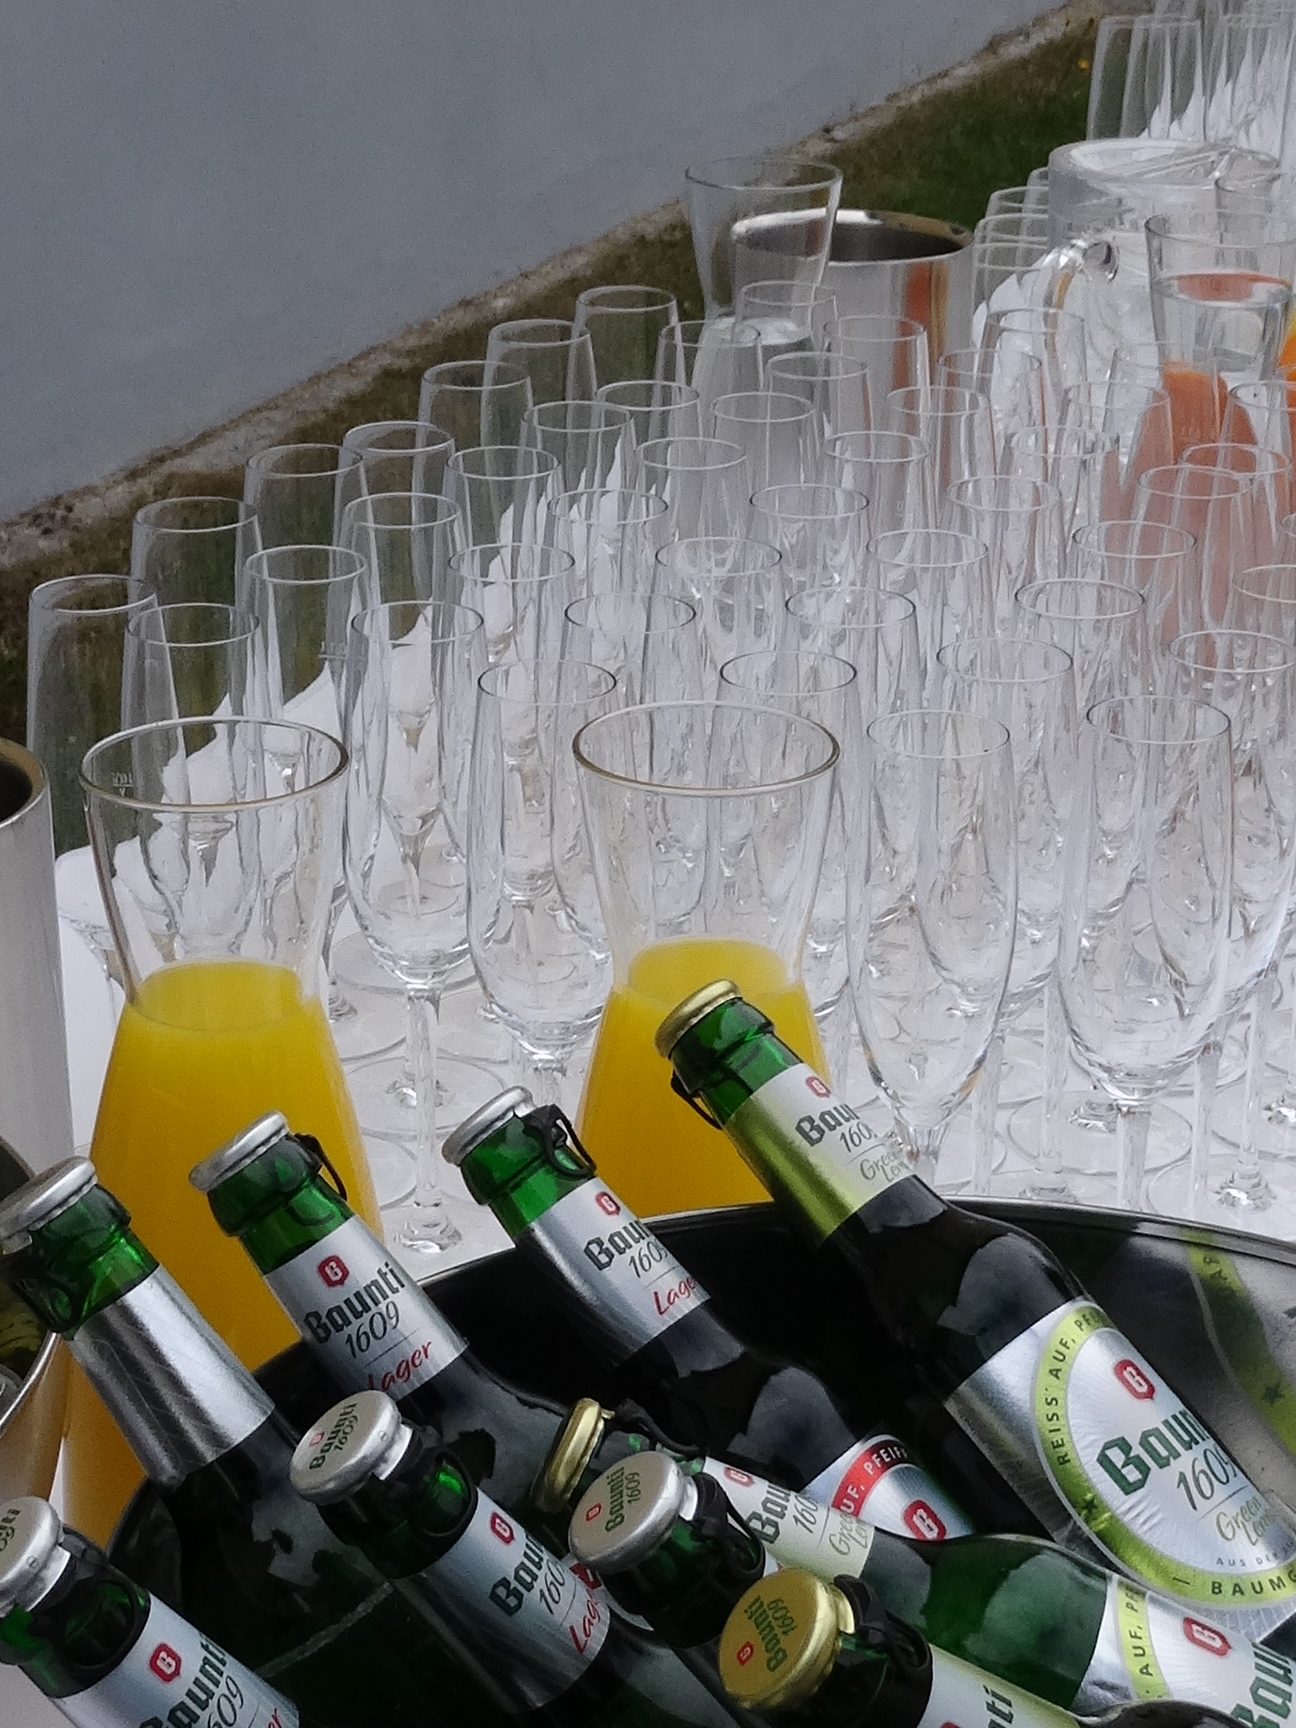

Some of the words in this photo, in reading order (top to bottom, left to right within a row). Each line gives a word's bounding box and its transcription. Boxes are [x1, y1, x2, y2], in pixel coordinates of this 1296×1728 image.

[839, 1122, 878, 1154] 160
[304, 1261, 406, 1344] Baunti
[653, 1274, 697, 1316] Lage
[344, 1300, 401, 1358] 1609
[309, 1402, 358, 1470] Baunti
[333, 1414, 359, 1451] 1609
[605, 1466, 625, 1533] Baunti
[627, 1471, 642, 1505] 1609
[1216, 1557, 1246, 1567] AUS
[743, 1594, 789, 1672] Baunti
[767, 1597, 796, 1636] 1609
